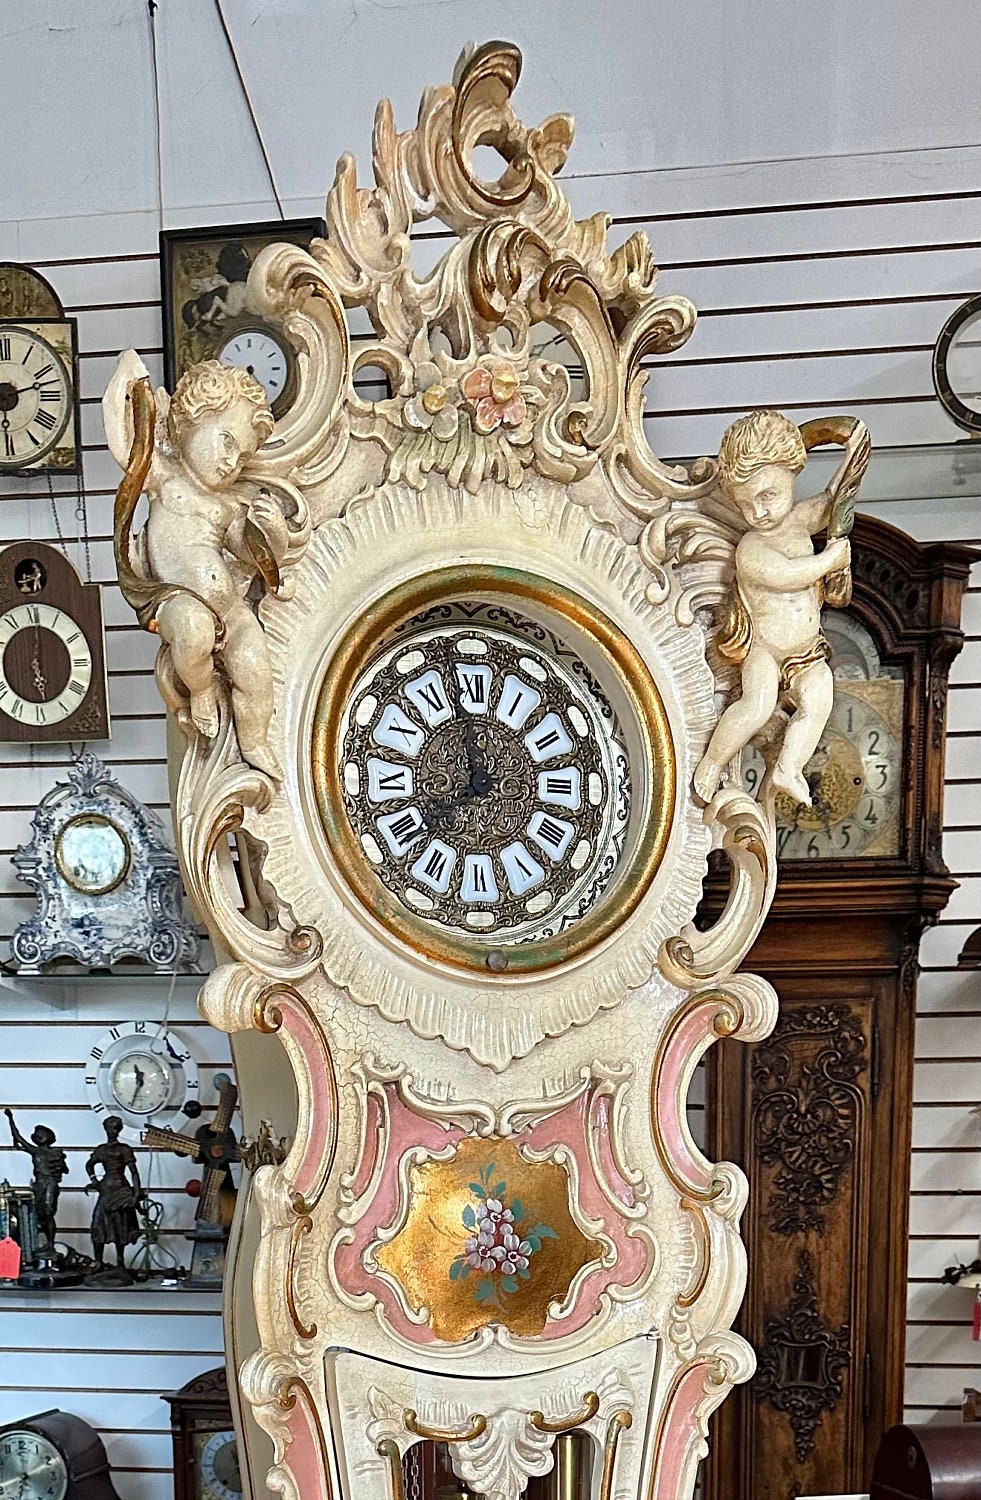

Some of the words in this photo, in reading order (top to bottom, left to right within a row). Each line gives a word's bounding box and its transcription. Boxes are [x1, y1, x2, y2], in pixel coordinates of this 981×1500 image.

[416, 682, 446, 717] XI
[462, 673, 485, 704] XII
[509, 691, 522, 718] I
[388, 717, 418, 747] X
[847, 707, 854, 732] 1
[535, 729, 560, 753] II
[868, 730, 881, 756] 2
[546, 777, 572, 796] III
[745, 768, 758, 793] 9
[875, 764, 889, 790] 3
[864, 799, 879, 824] 4
[536, 817, 567, 848] IIII
[841, 825, 853, 849] 5
[807, 834, 820, 858] 6
[514, 856, 531, 881] V
